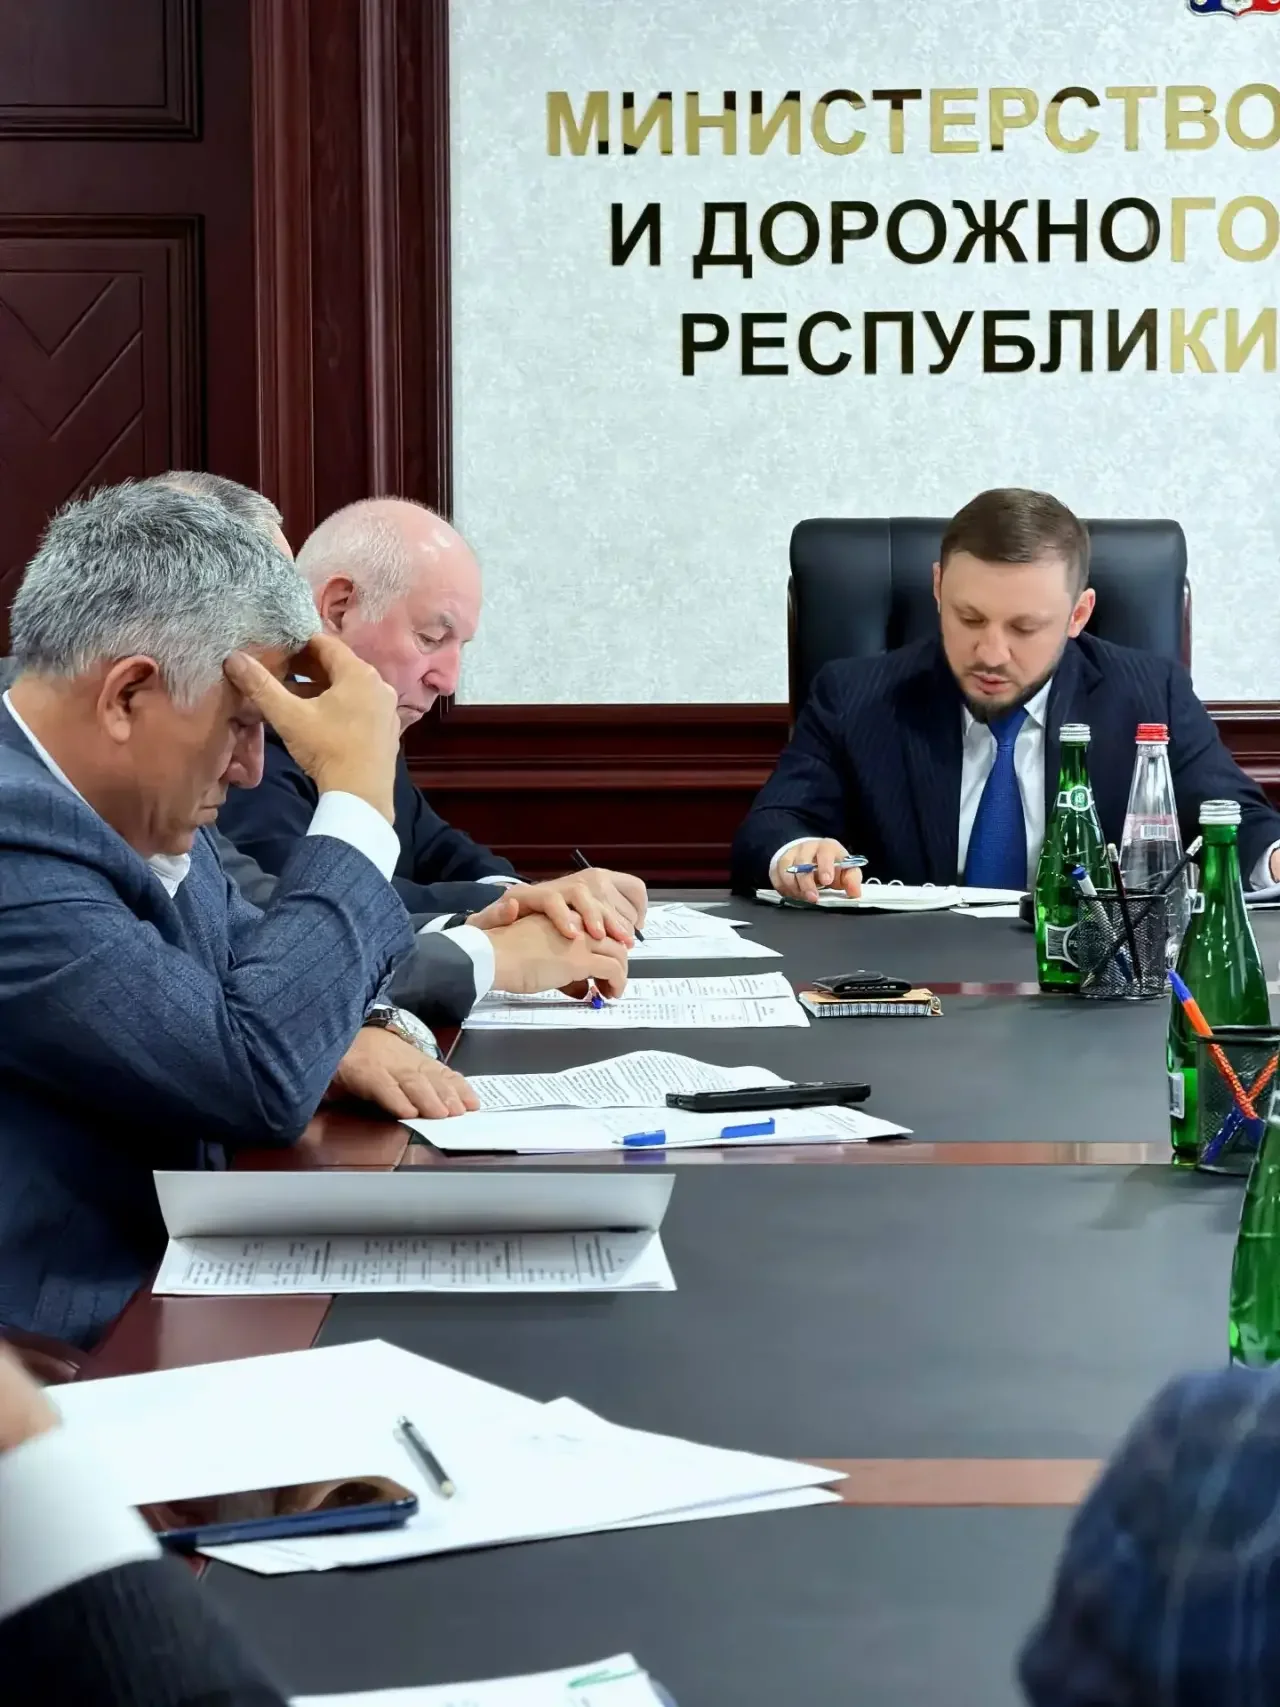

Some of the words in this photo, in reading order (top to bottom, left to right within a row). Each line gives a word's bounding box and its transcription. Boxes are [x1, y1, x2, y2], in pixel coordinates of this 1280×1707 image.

[545, 83, 1280, 156] МИНИСТЕРСТВО
[610, 202, 661, 266] И
[692, 195, 1280, 279] ДОРОЖНОГО
[681, 307, 1278, 376] РЕСПУБЛИКИ
